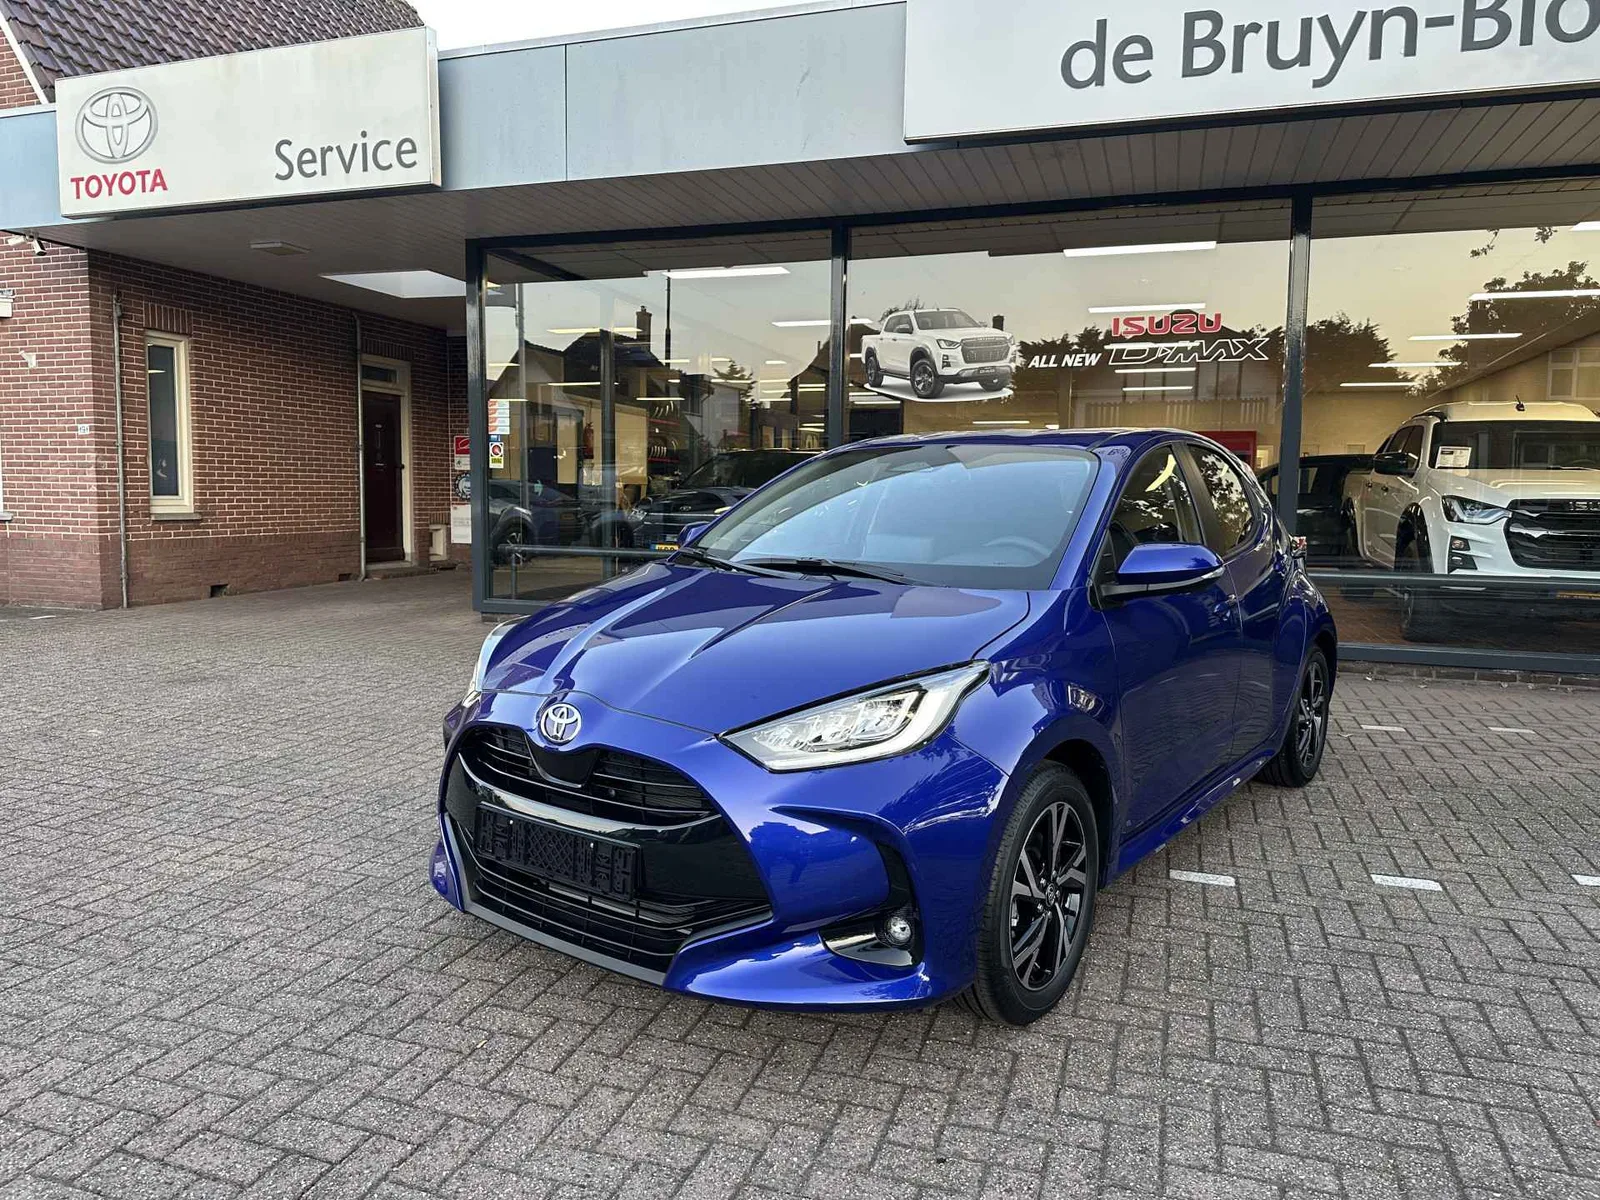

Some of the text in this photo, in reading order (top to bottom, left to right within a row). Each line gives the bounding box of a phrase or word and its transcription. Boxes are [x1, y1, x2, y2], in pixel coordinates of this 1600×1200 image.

[1060, 18, 1154, 90] de
[274, 130, 417, 181] Service
[70, 168, 168, 199] TOYOTA
[1111, 312, 1222, 338] ISUZU
[1028, 353, 1058, 369] ALL
[1061, 353, 1102, 368] NEW
